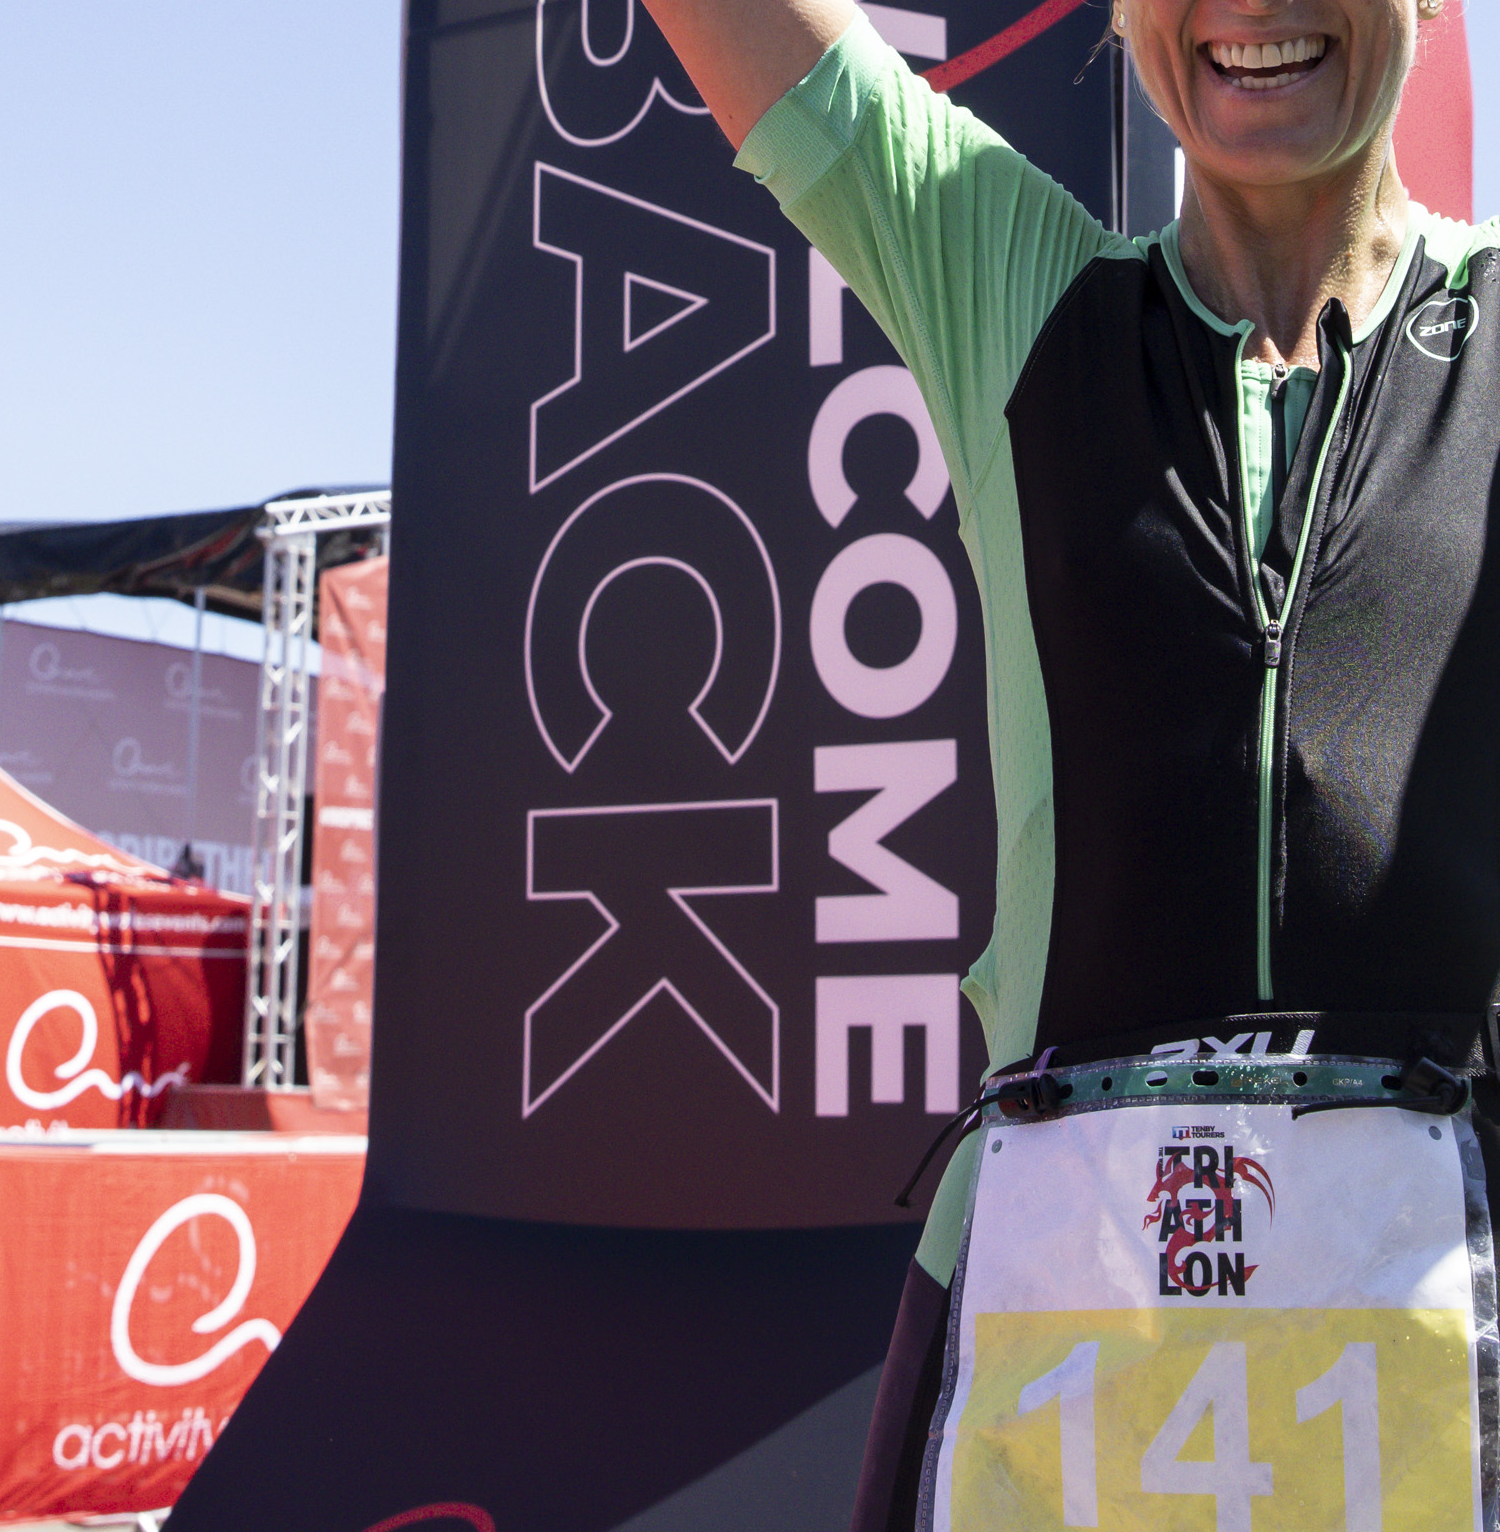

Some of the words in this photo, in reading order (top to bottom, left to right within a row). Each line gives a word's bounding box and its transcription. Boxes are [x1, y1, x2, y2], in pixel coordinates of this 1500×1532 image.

[1191, 1131, 1225, 1139] TOURERS
[1164, 1145, 1234, 1189] TRI
[1158, 1198, 1243, 1242] ATH
[1158, 1250, 1246, 1298] LON
[1017, 1340, 1382, 1532] 141
